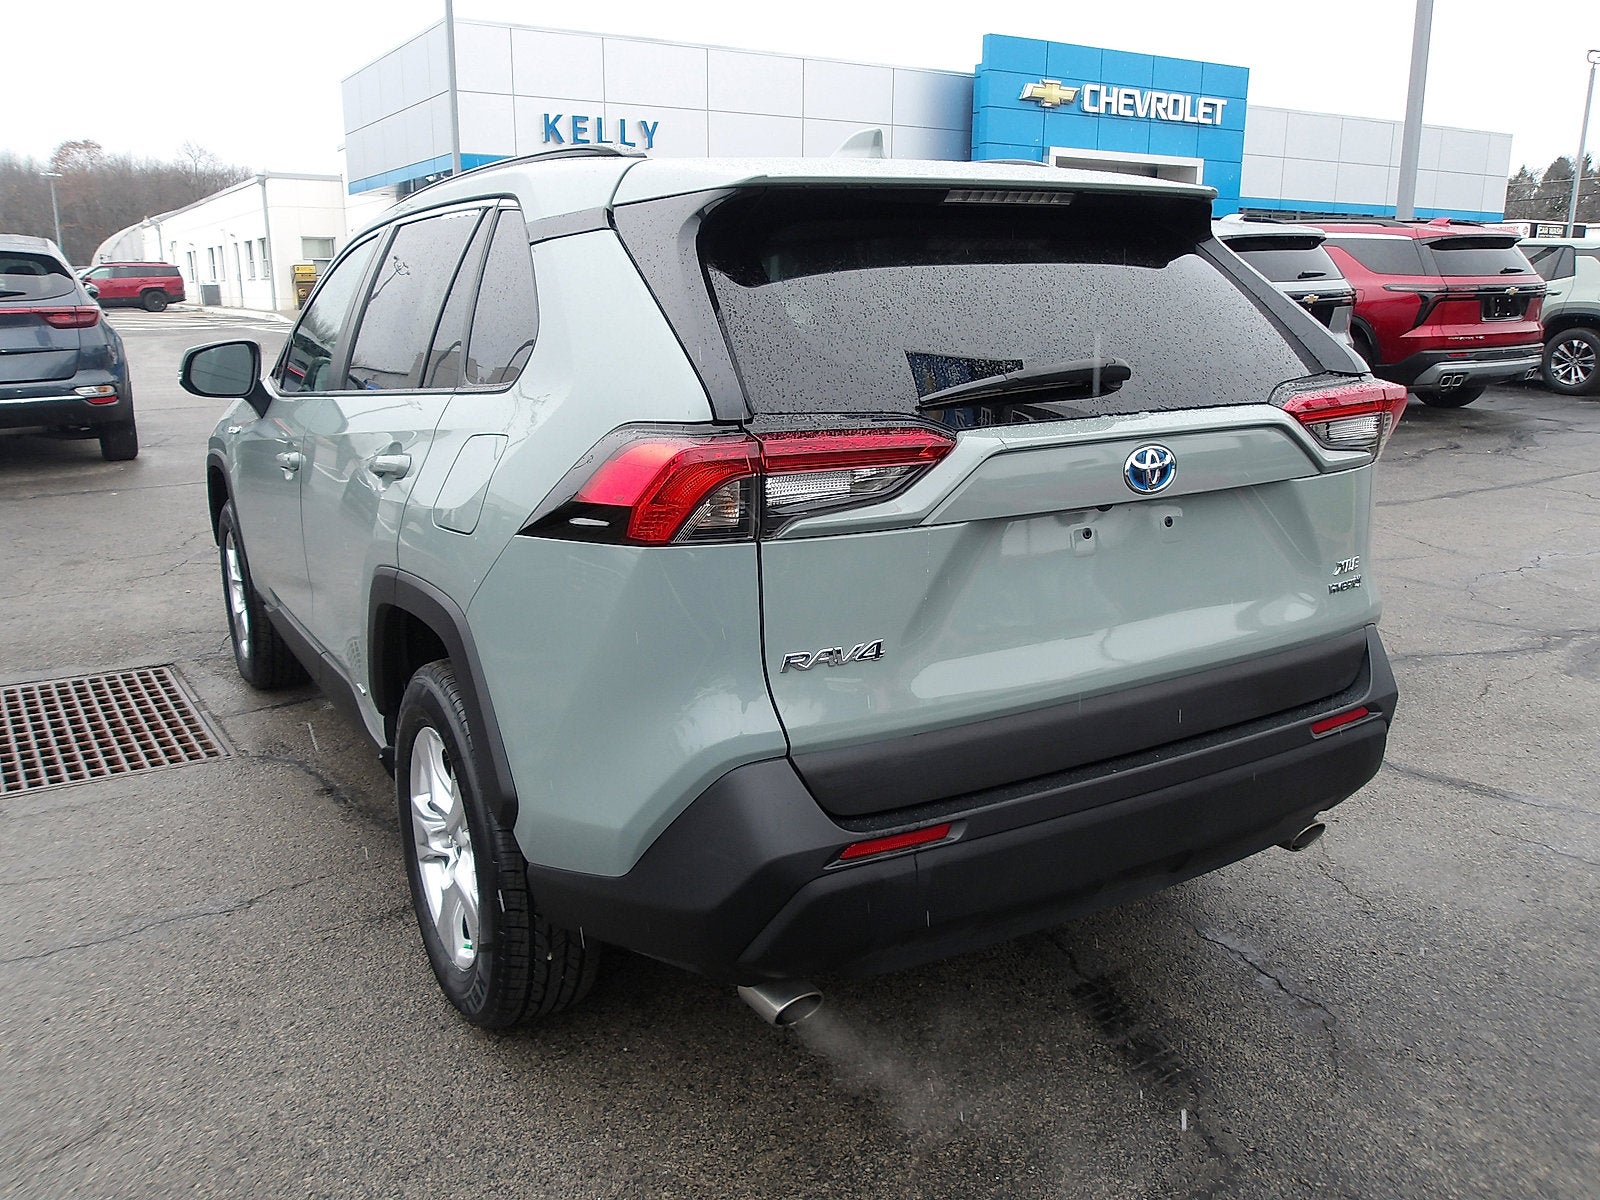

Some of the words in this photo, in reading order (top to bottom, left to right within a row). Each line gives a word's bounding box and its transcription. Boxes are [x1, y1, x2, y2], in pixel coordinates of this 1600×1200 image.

[1081, 83, 1228, 126] CHEVROLET
[543, 113, 659, 149] KELLY
[780, 638, 886, 673] RAV4
